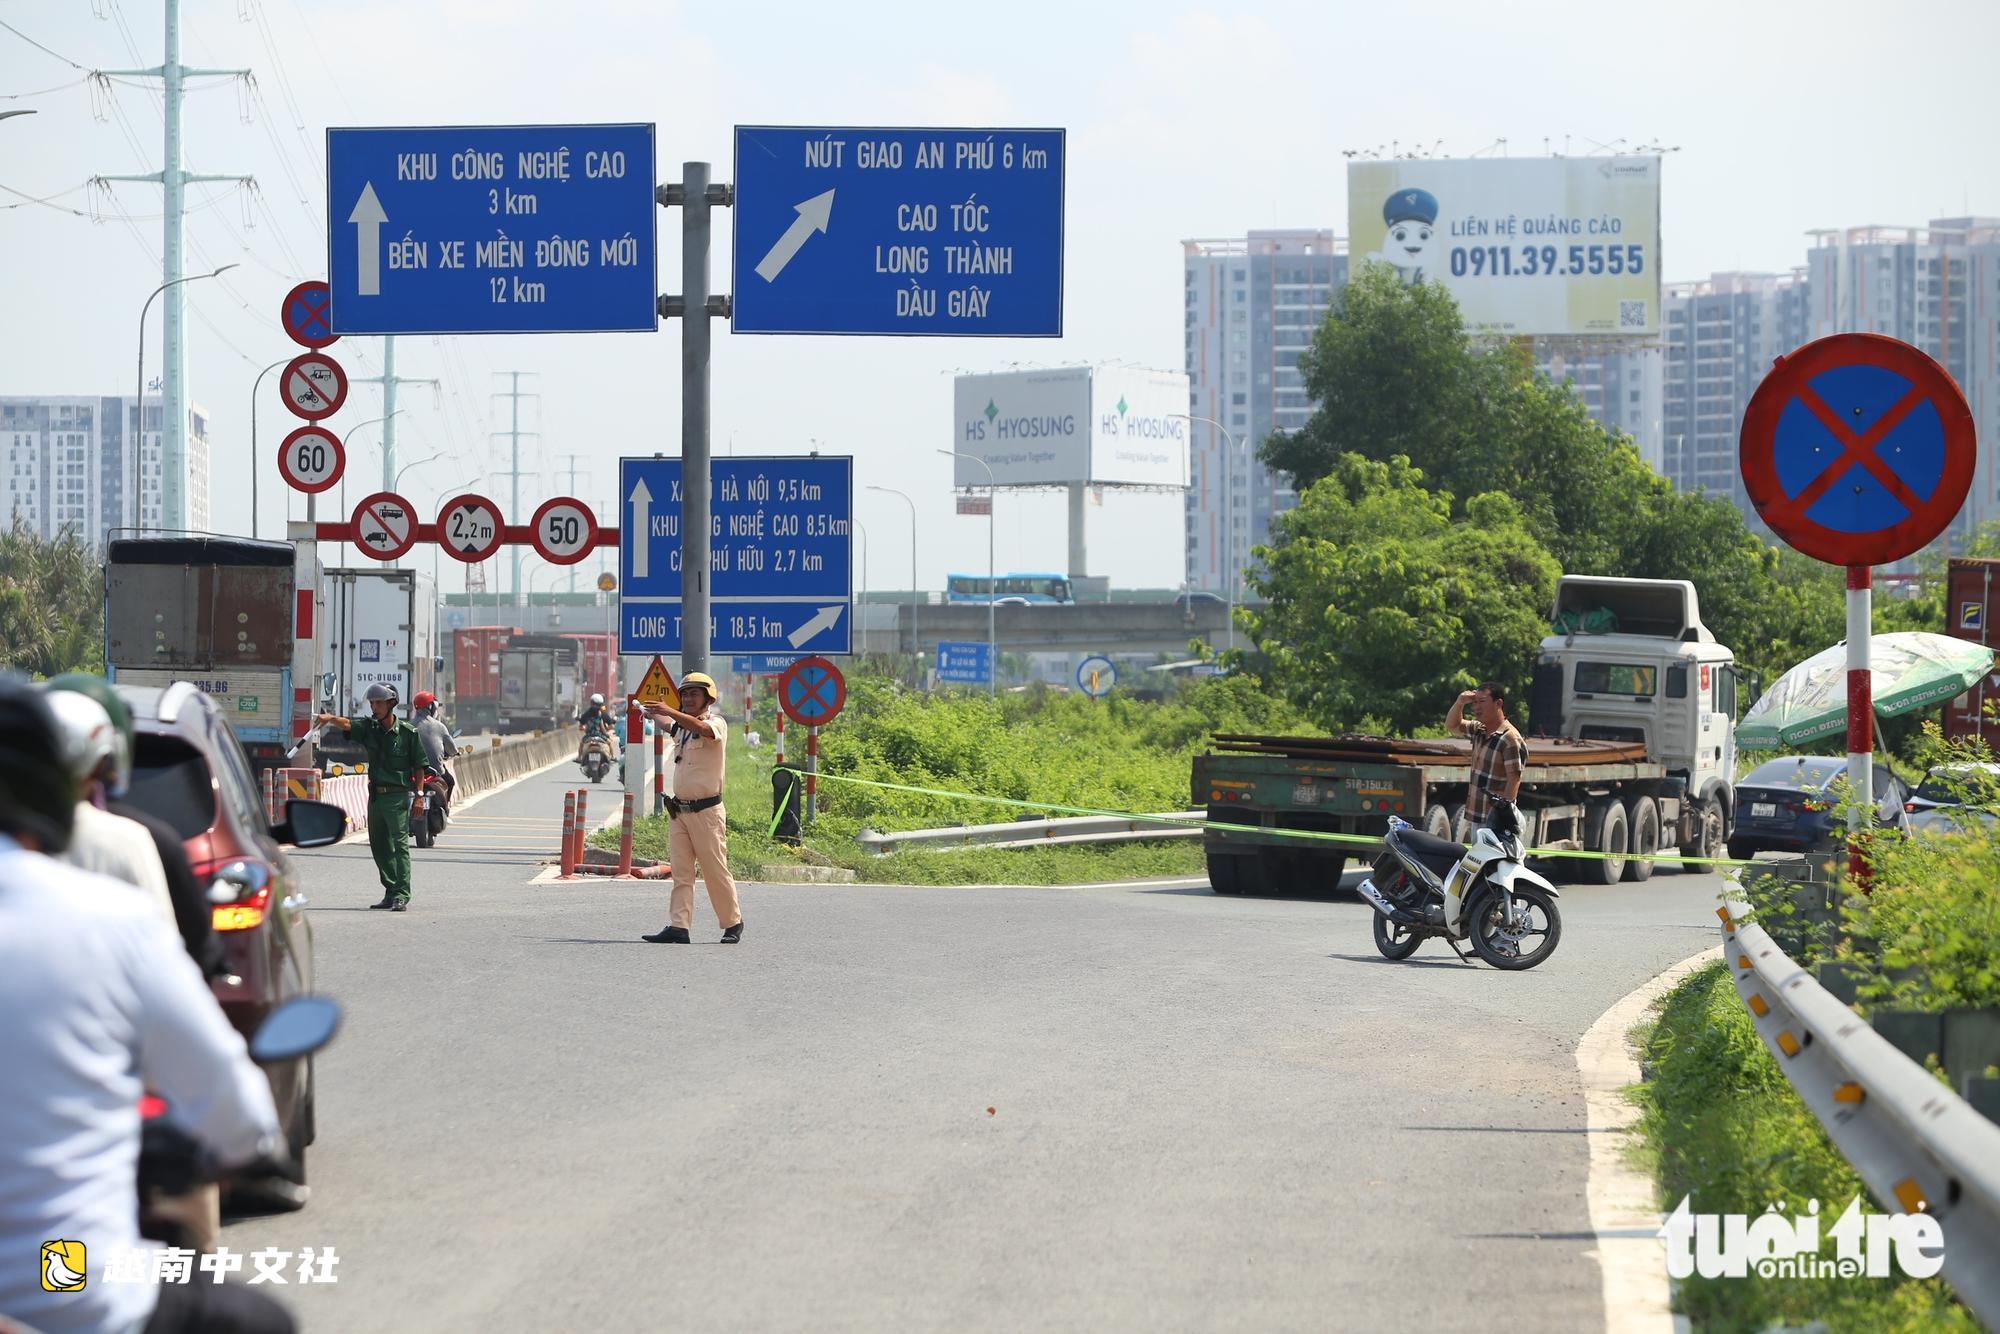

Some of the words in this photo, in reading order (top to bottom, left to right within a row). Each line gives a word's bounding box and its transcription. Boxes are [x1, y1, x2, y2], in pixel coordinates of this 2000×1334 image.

[398, 152, 437, 181] KHU
[451, 148, 504, 180] CÔNG
[518, 146, 570, 183] NGHỆ
[585, 151, 626, 179] CAO
[805, 134, 845, 168] NÚT
[857, 141, 903, 169] GIAO
[915, 142, 944, 169] AN
[956, 135, 994, 170] PHÚ
[1003, 143, 1013, 169] 6
[1022, 142, 1048, 169] km
[488, 188, 499, 215] 3
[505, 187, 537, 214] km
[897, 204, 937, 232] CAO
[950, 192, 990, 232] TỐC
[1451, 215, 1488, 236] LIÊN
[1495, 214, 1517, 239] HỆ
[1523, 213, 1582, 236] QUẢNG
[388, 230, 428, 269] BẾN
[438, 240, 465, 268] XE
[476, 228, 524, 268] MIỀN
[534, 235, 589, 267] ĐÔNG
[600, 232, 638, 266] MỚI
[876, 246, 928, 273] LONG
[944, 240, 1013, 274] THÀNH
[1450, 244, 1644, 277] 0911.39.5555
[489, 277, 507, 303] 12
[513, 276, 545, 303] km
[896, 278, 936, 317] DẦU
[948, 285, 991, 318] GIÂY
[966, 420, 985, 441] HS
[998, 414, 1075, 440] HYOSUNG
[1102, 414, 1118, 436] HS
[1127, 417, 1183, 440] HYOSUNG
[297, 445, 326, 473] 60
[721, 474, 739, 501] HÀ
[748, 473, 769, 505] NỘI
[452, 512, 477, 540] 2,2
[549, 516, 579, 545] 50
[652, 515, 678, 537] KHU
[730, 509, 764, 541] NGHỆ
[773, 514, 798, 536] CAO
[709, 545, 729, 572] HÚ
[738, 545, 764, 572] HỮU
[632, 616, 666, 638] LONG
